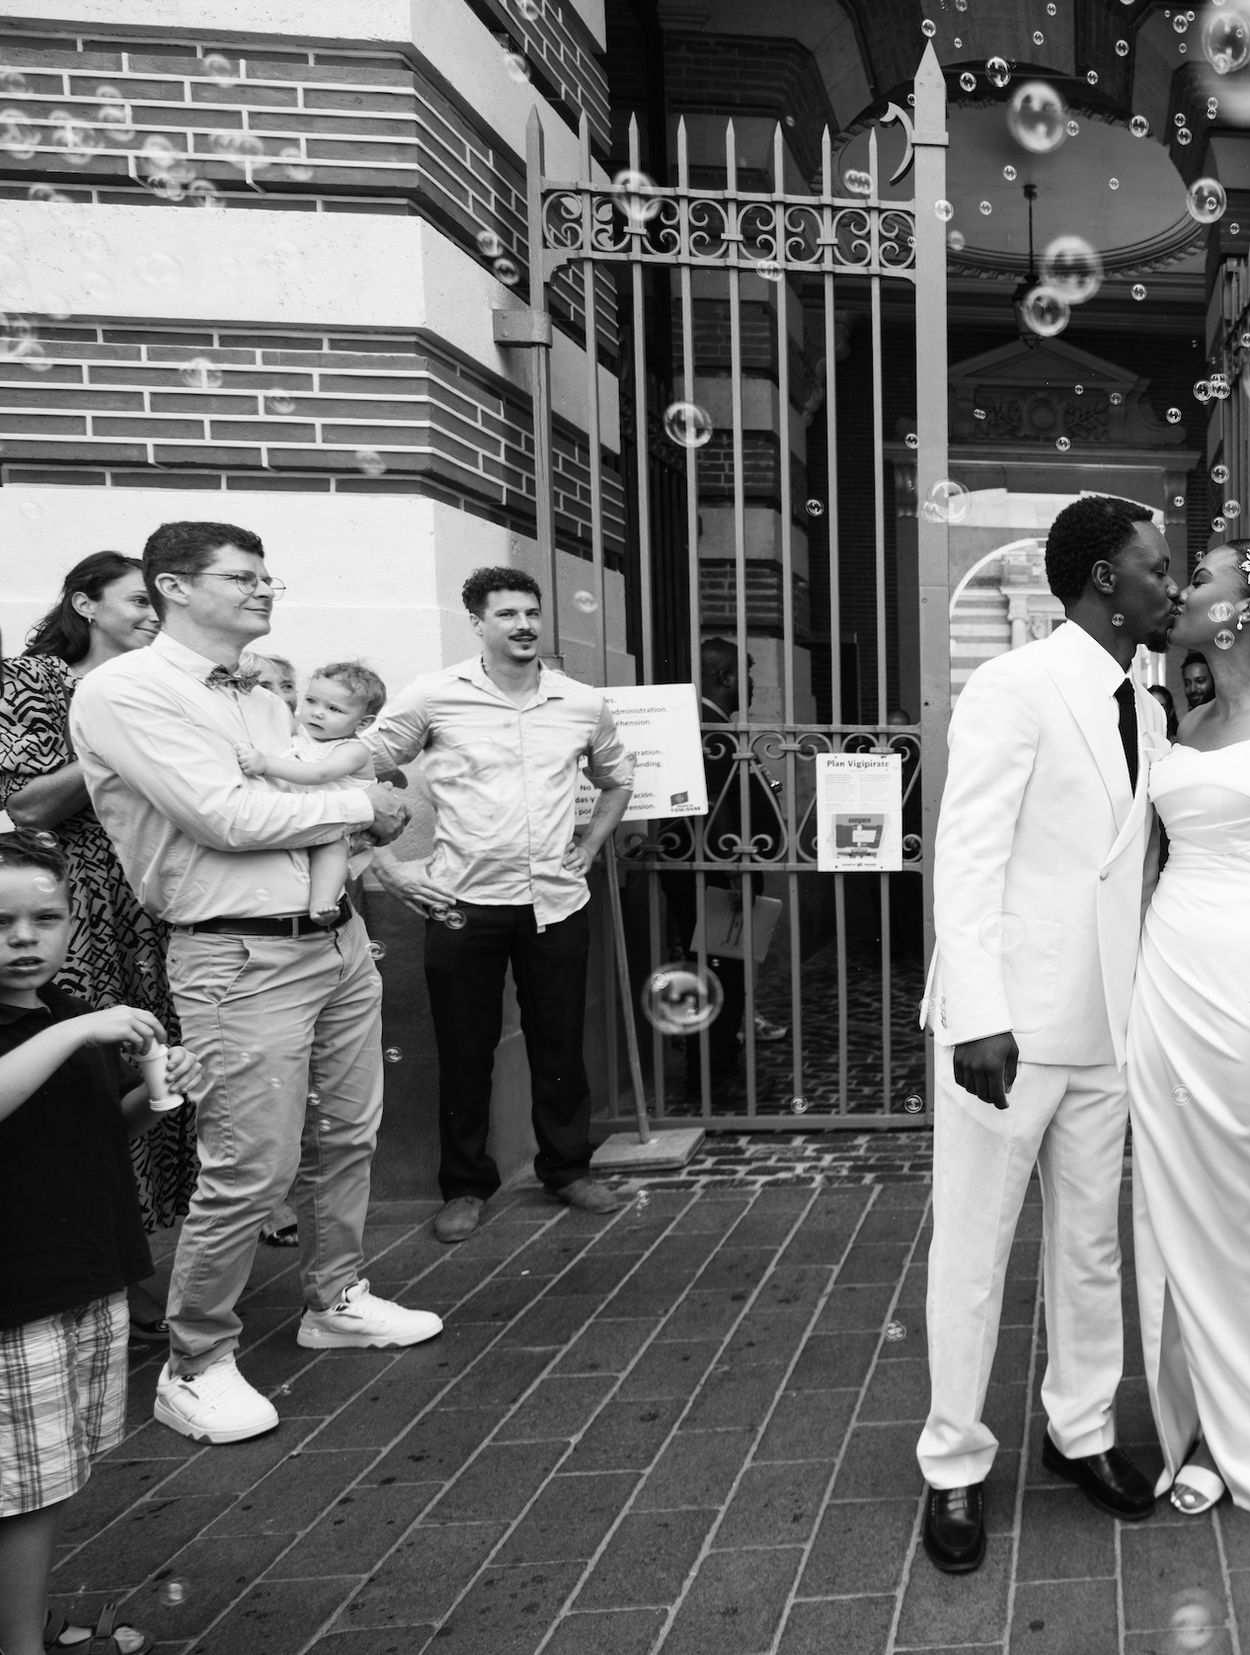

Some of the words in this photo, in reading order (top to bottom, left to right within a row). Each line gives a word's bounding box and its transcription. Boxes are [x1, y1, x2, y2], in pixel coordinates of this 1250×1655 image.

[827, 759, 845, 767] Plan
[848, 759, 889, 769] Vigipirate
[633, 791, 656, 799] ación.
